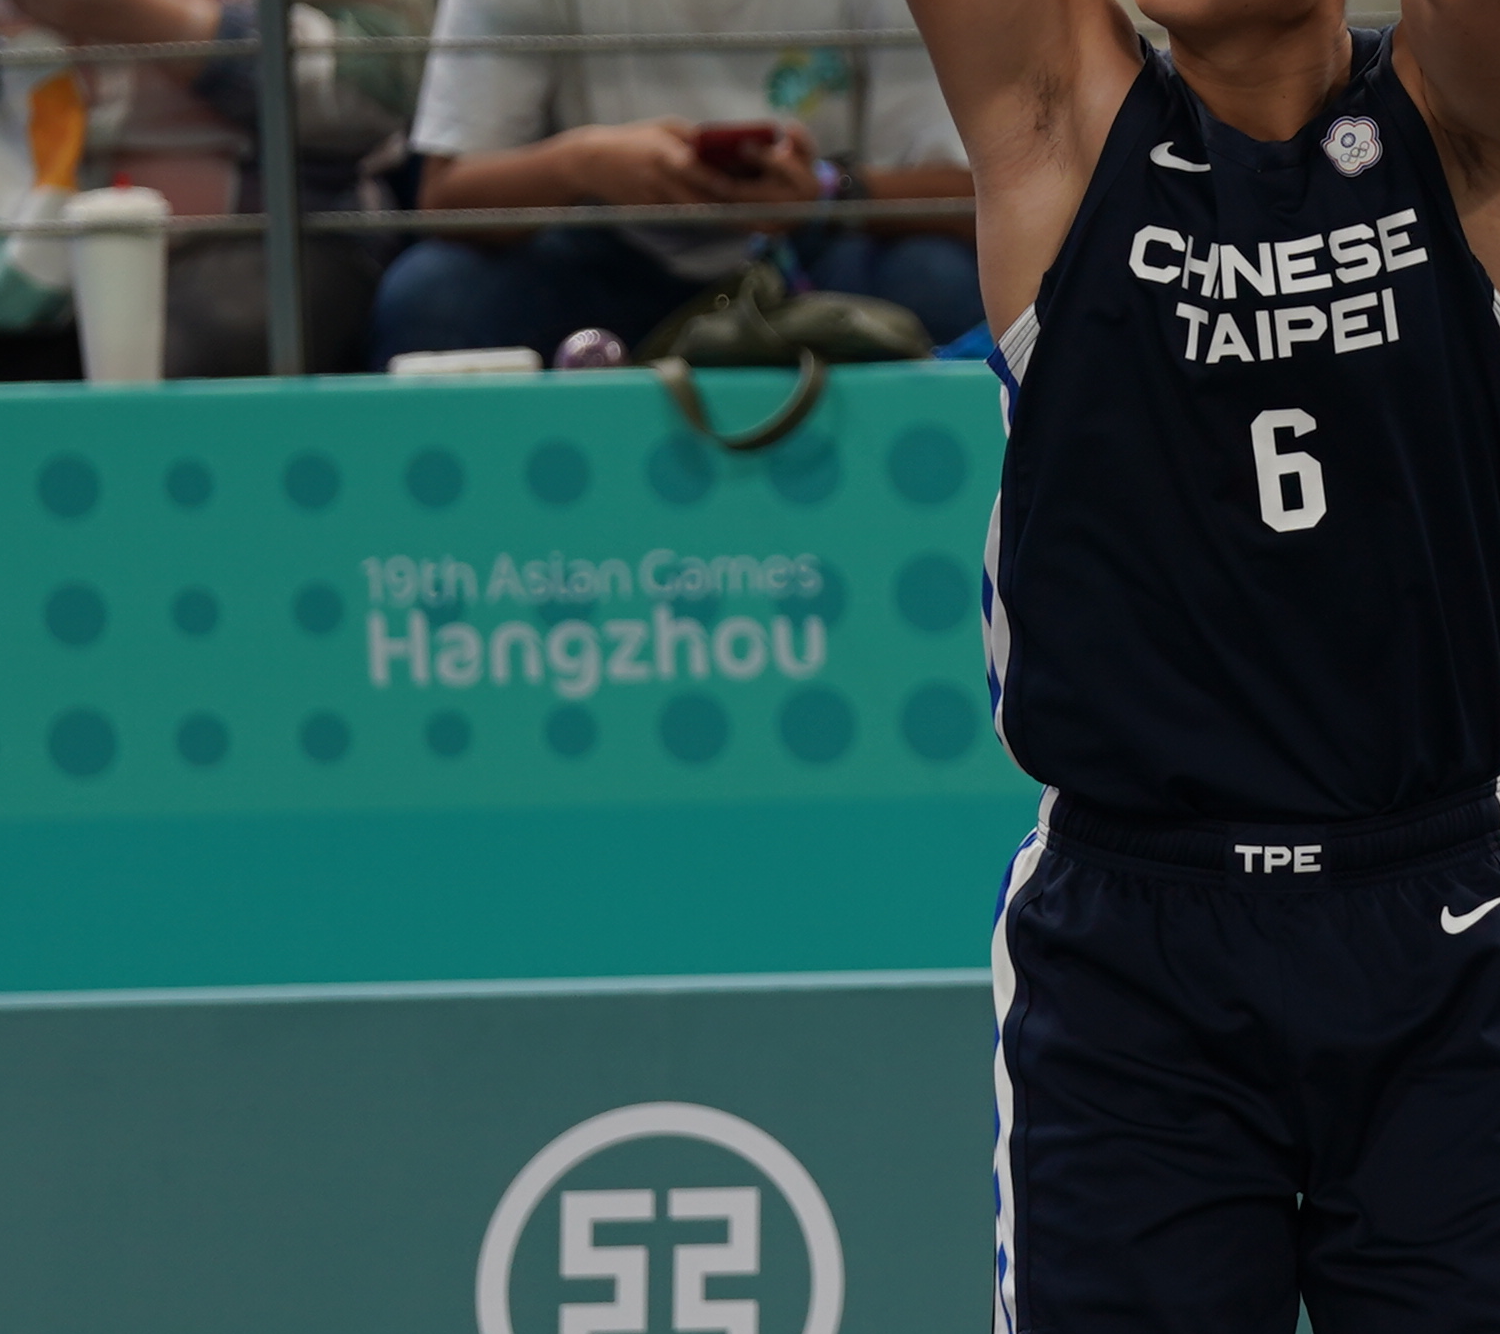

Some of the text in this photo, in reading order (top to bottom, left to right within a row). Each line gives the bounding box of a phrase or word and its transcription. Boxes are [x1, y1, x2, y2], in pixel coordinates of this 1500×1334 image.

[1175, 287, 1400, 364] TAIPEI
[1250, 407, 1328, 534] 6
[362, 547, 825, 608] 19th Asian Games
[365, 602, 828, 701] Hangzhou
[1234, 843, 1322, 873] TPE
